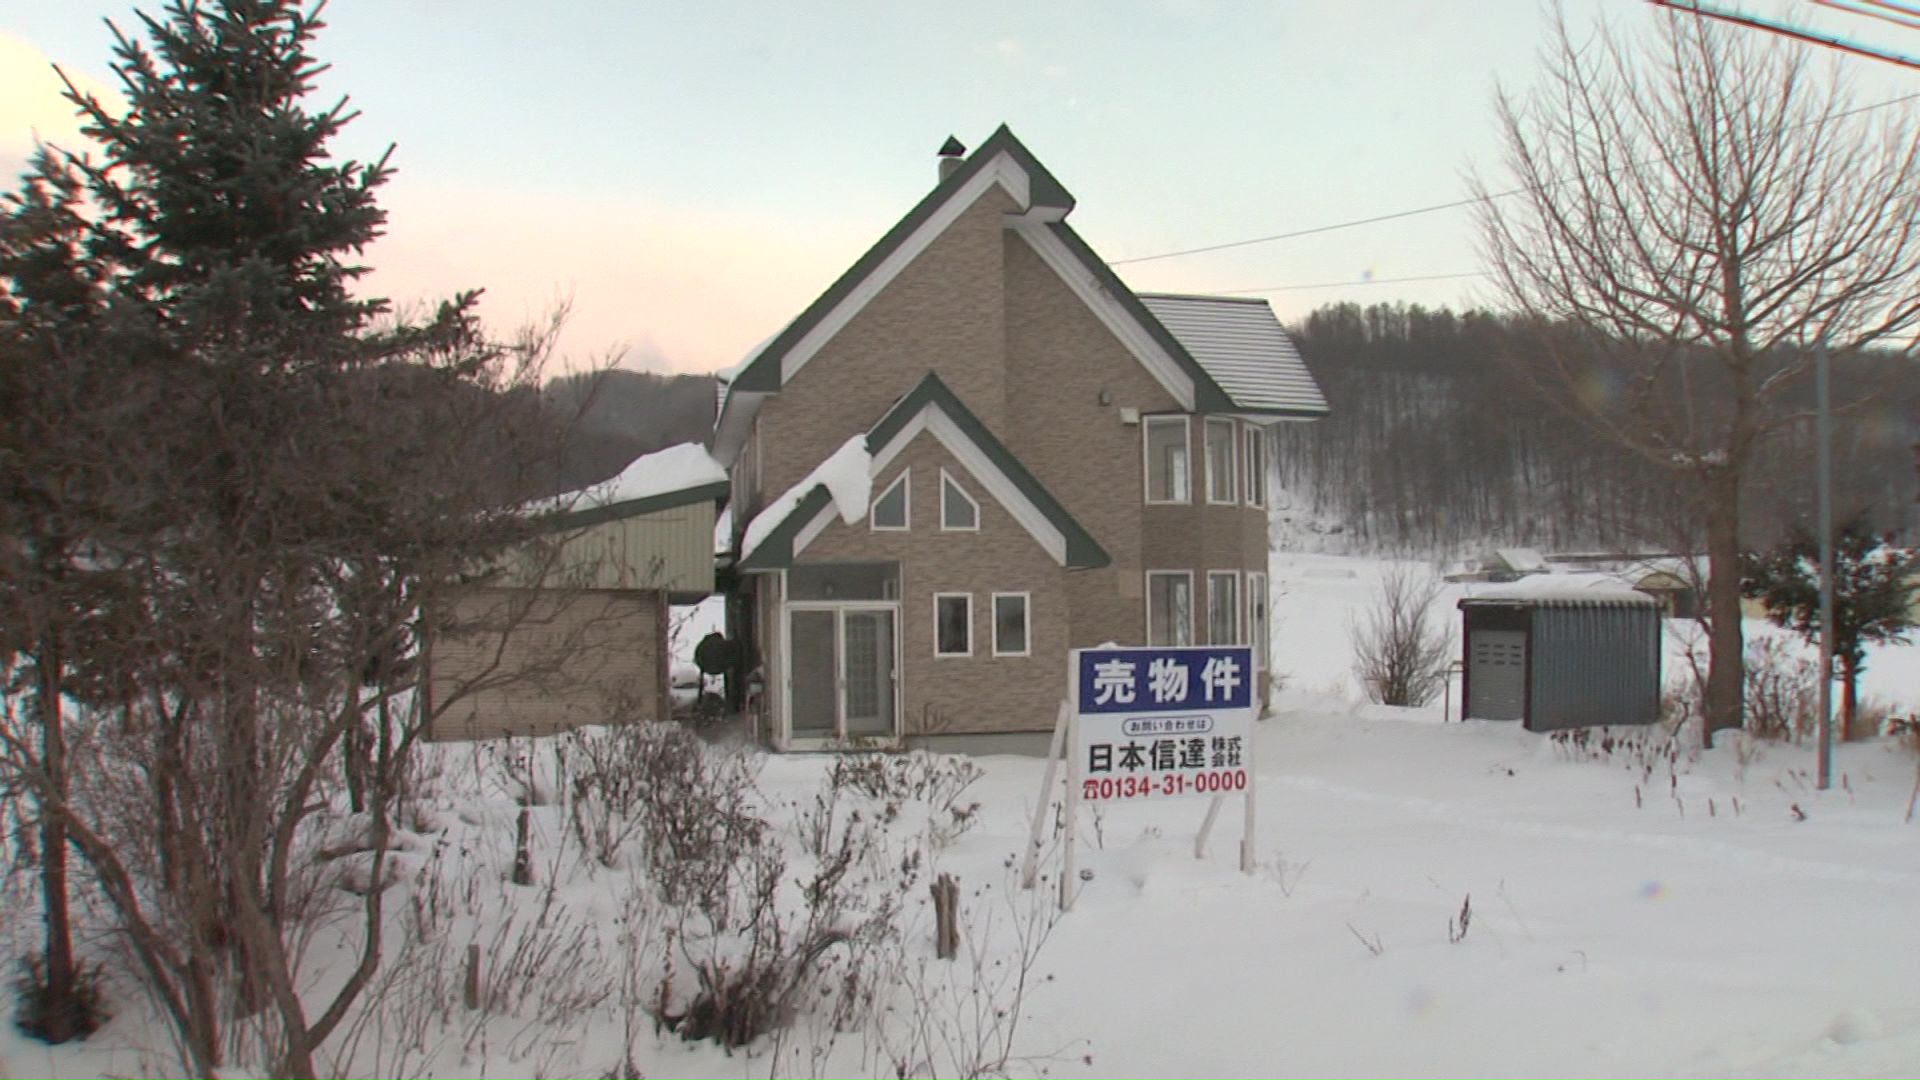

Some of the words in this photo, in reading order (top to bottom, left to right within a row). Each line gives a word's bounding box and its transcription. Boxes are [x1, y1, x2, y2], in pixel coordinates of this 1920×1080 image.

[1093, 656, 1241, 705] 売物件
[1130, 719, 1206, 732] お問い合わせは
[1089, 738, 1206, 773] 日本信達
[1100, 770, 1246, 800] 0134-31-0000
